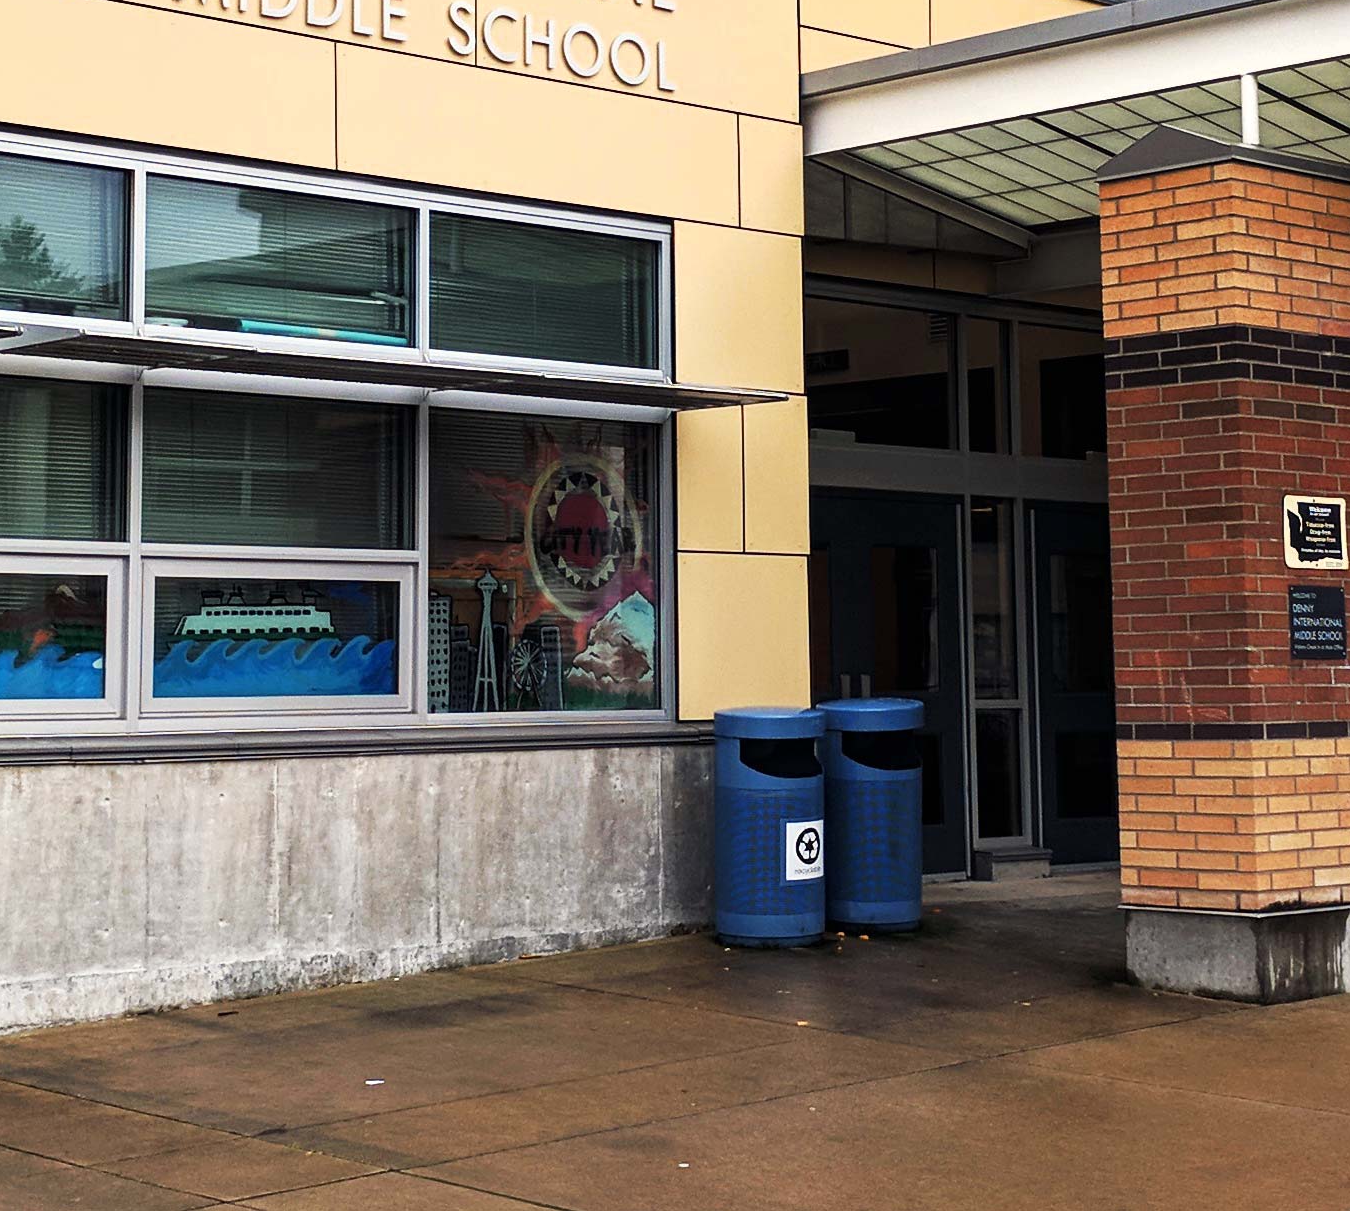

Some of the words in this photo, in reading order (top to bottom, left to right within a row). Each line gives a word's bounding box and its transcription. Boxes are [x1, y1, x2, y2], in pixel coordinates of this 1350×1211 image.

[447, 0, 677, 94] SCHOOL
[1292, 603, 1315, 613] DENNY
[1292, 617, 1343, 628] INTERNATIONAL
[1294, 630, 1317, 641] MIDDLE
[1317, 630, 1344, 641] SCHOOL
